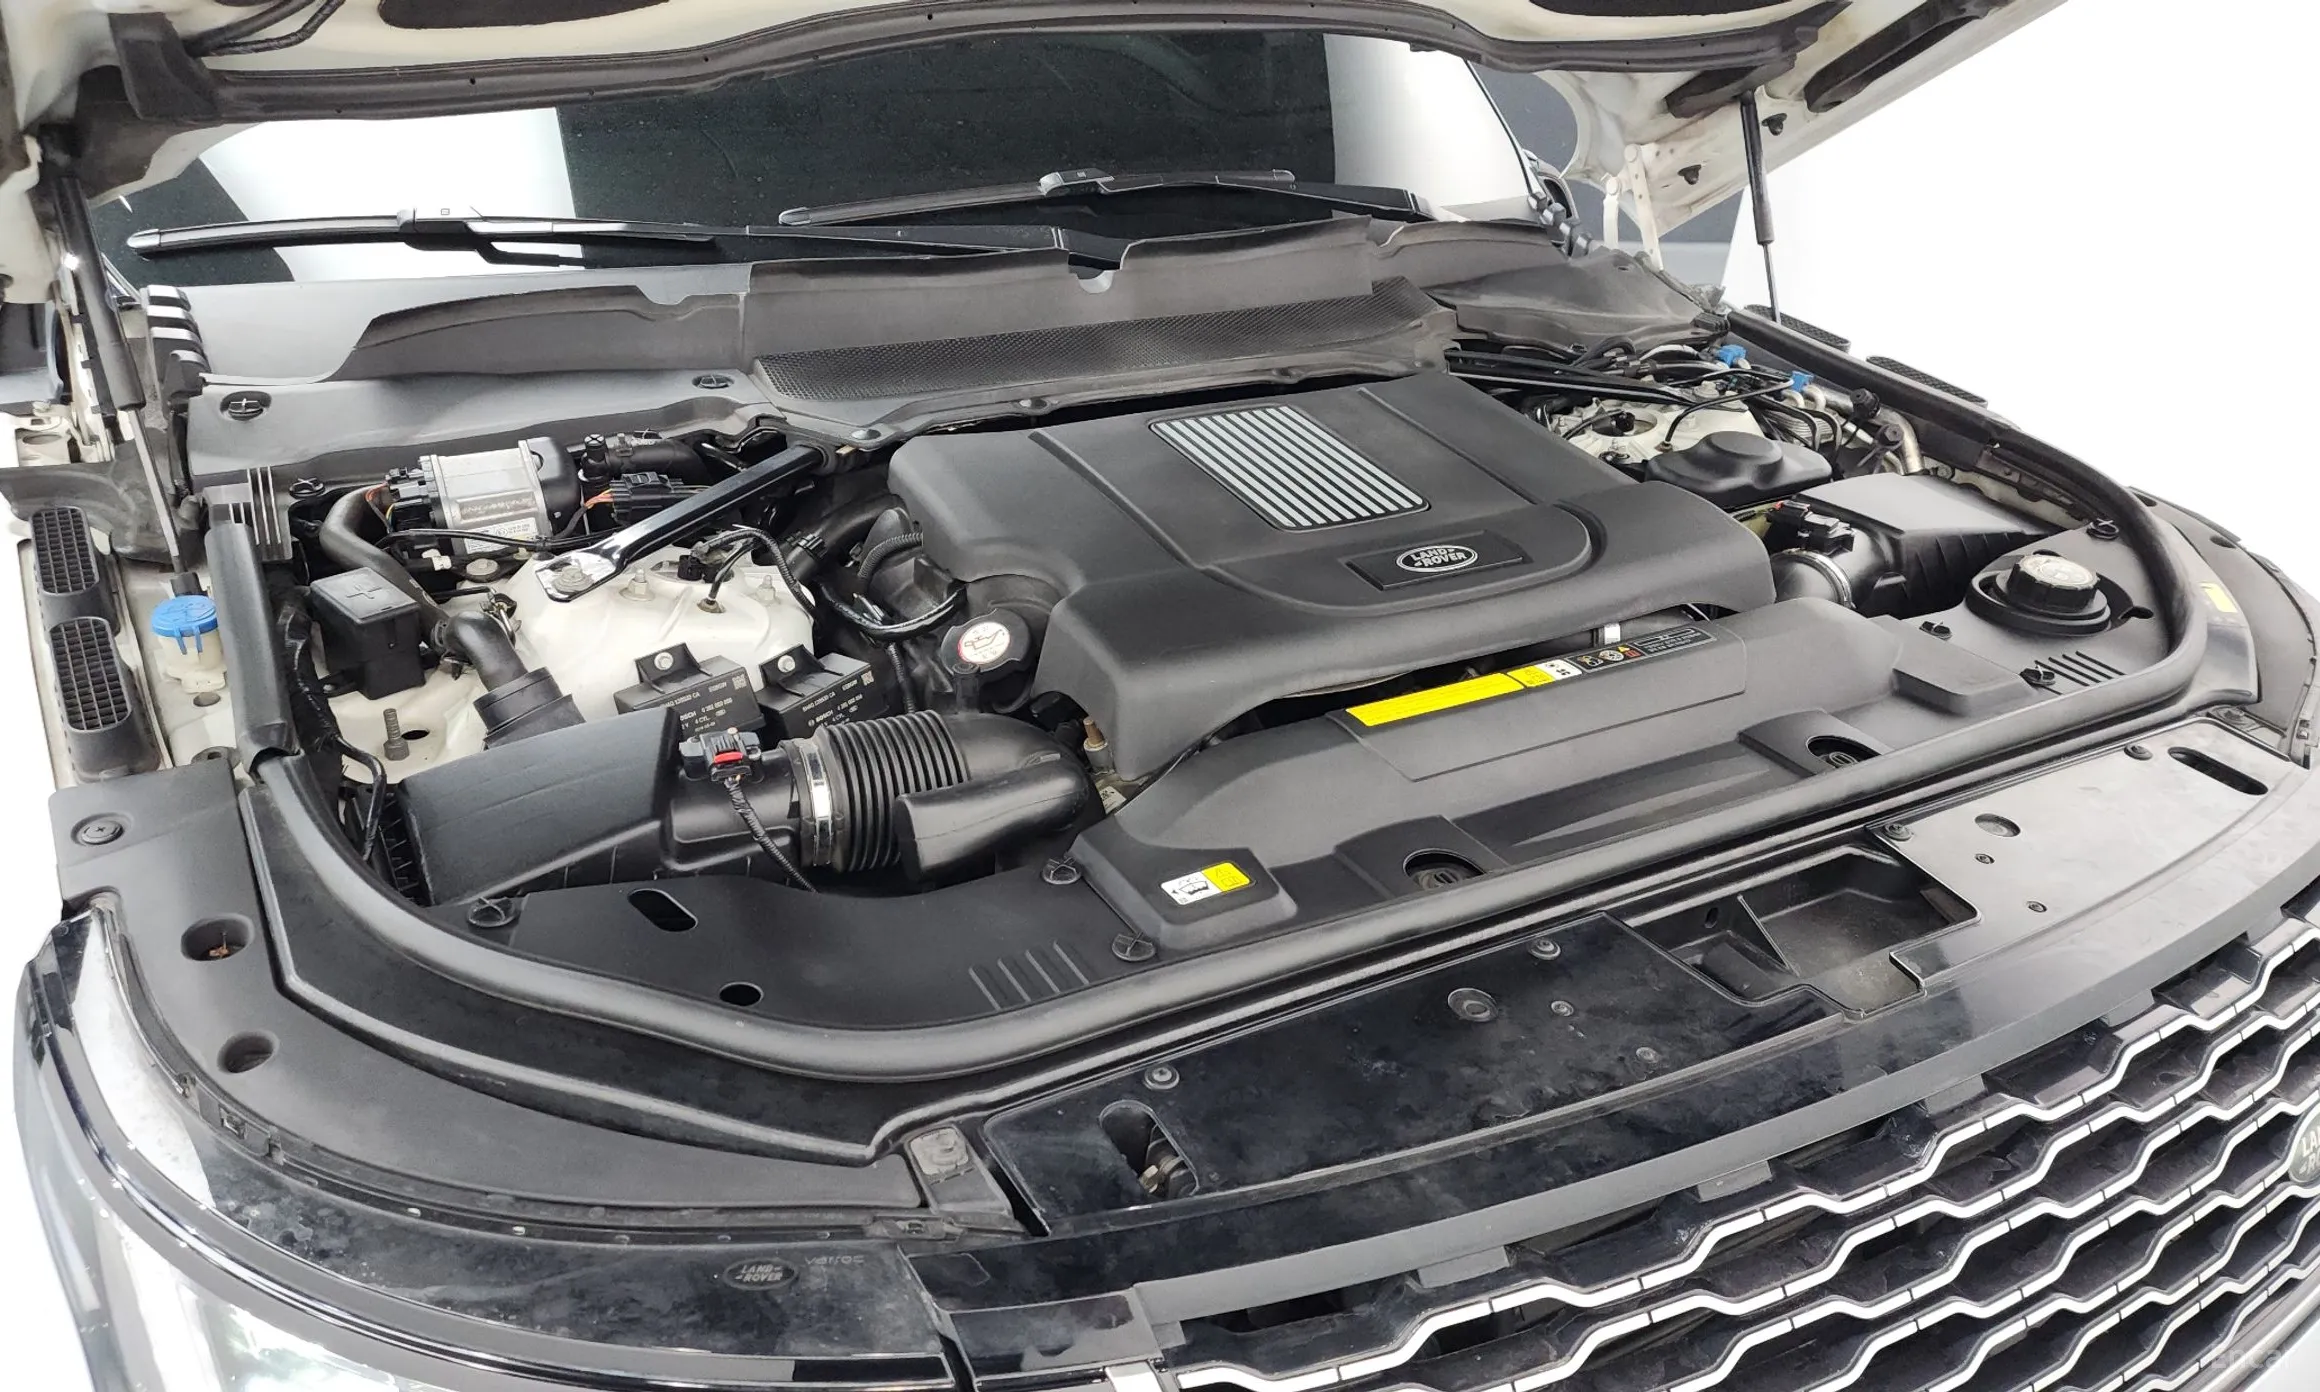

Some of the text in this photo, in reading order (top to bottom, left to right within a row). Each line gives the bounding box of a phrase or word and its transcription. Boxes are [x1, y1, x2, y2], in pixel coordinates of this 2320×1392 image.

[1410, 548, 1448, 561] LAND
[1421, 552, 1467, 567] ROVER
[741, 1263, 772, 1274] LAND
[743, 1272, 783, 1282] ROVER
